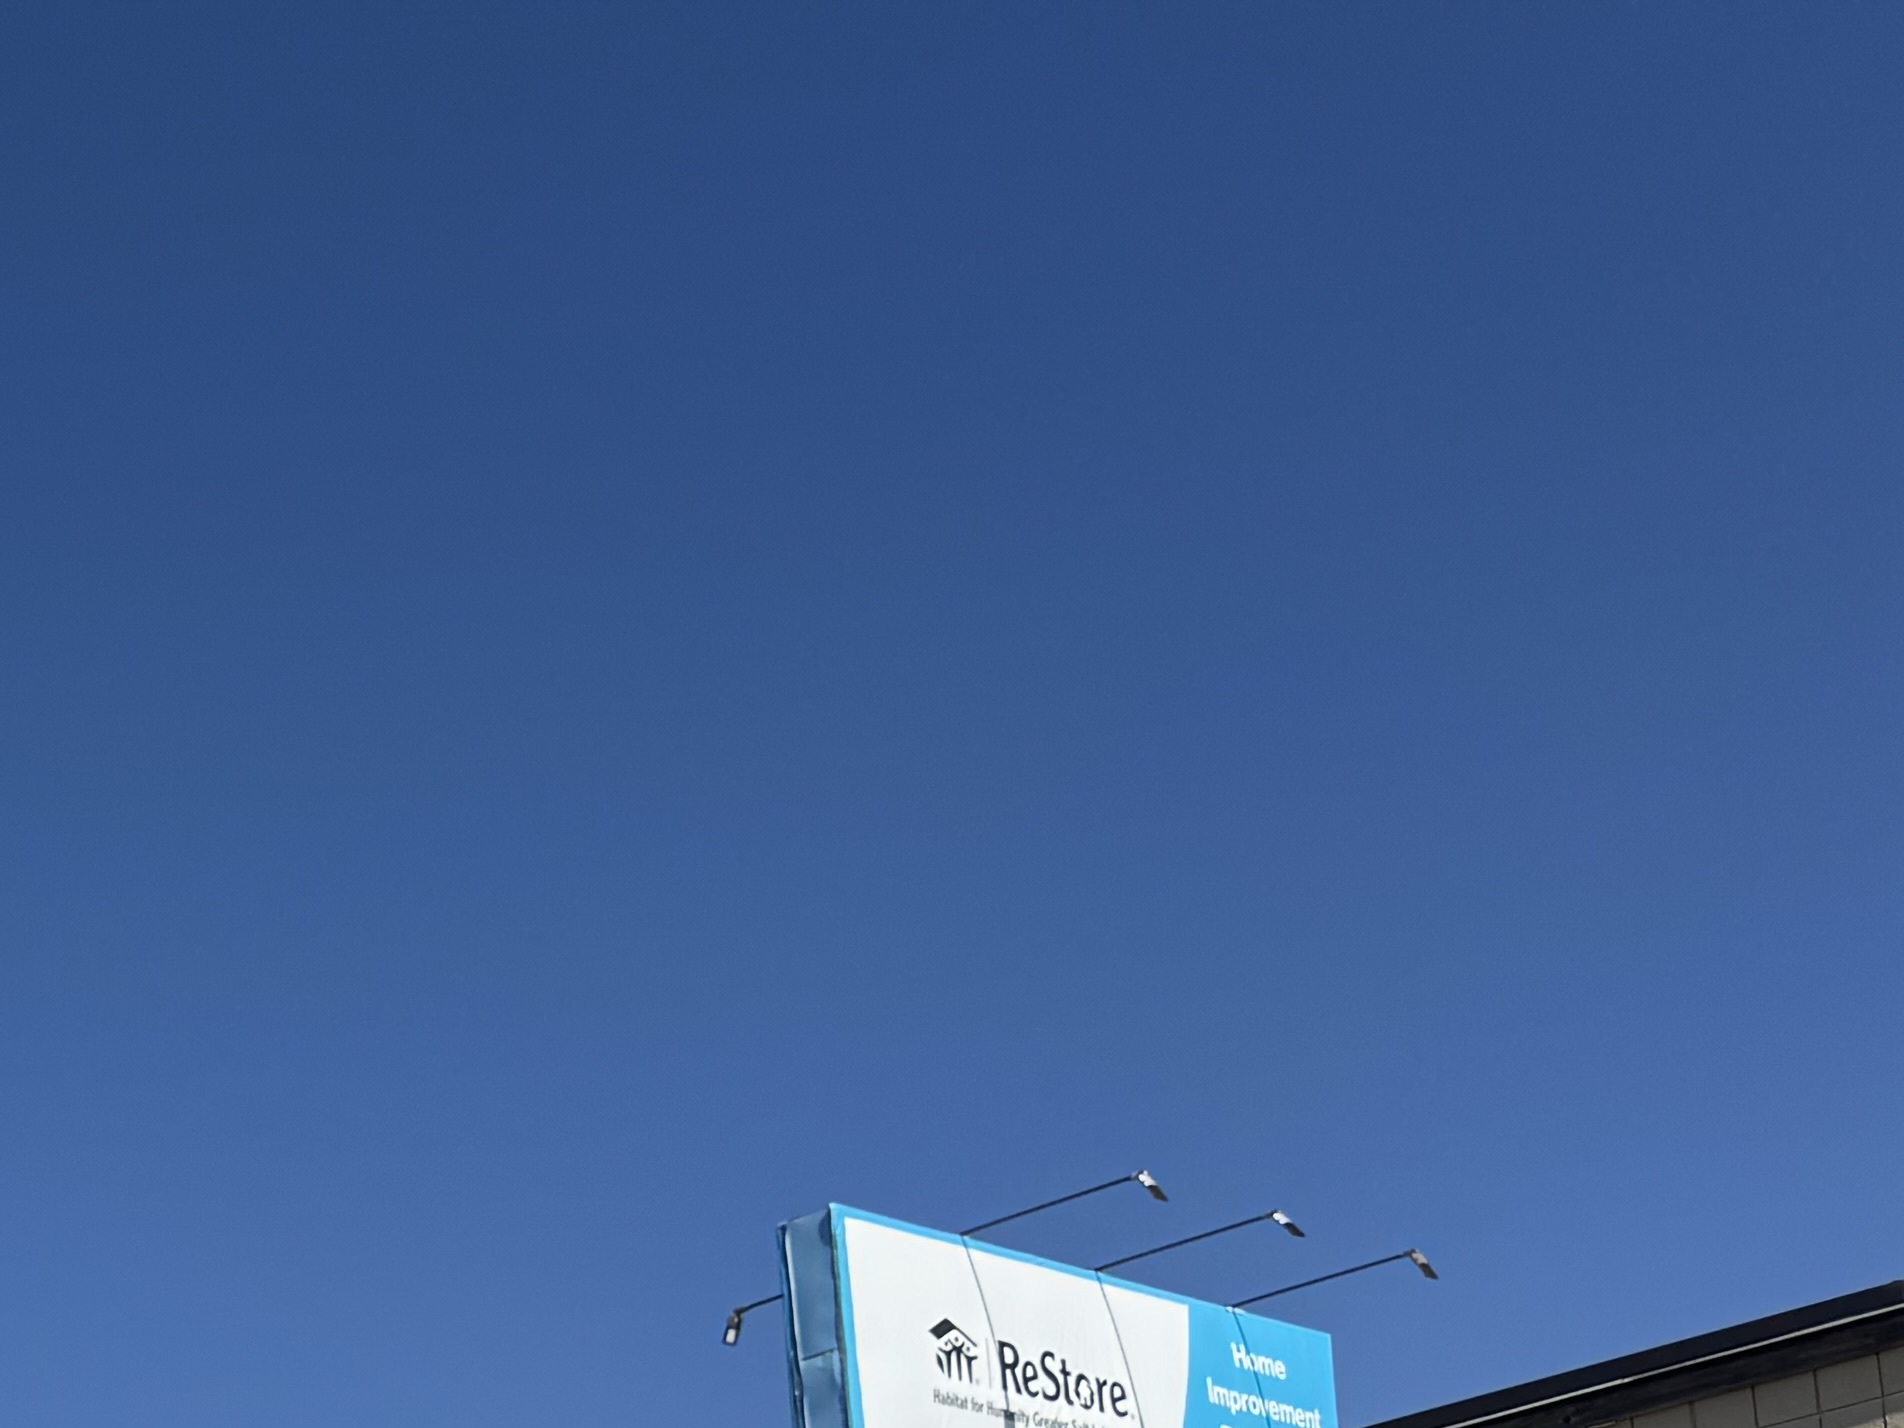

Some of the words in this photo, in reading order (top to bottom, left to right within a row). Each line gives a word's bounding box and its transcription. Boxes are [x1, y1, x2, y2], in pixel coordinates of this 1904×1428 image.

[997, 1339, 1129, 1418] ReStore
[1229, 1341, 1287, 1381] Home
[933, 1389, 969, 1410] Habitat
[971, 1396, 985, 1414] for
